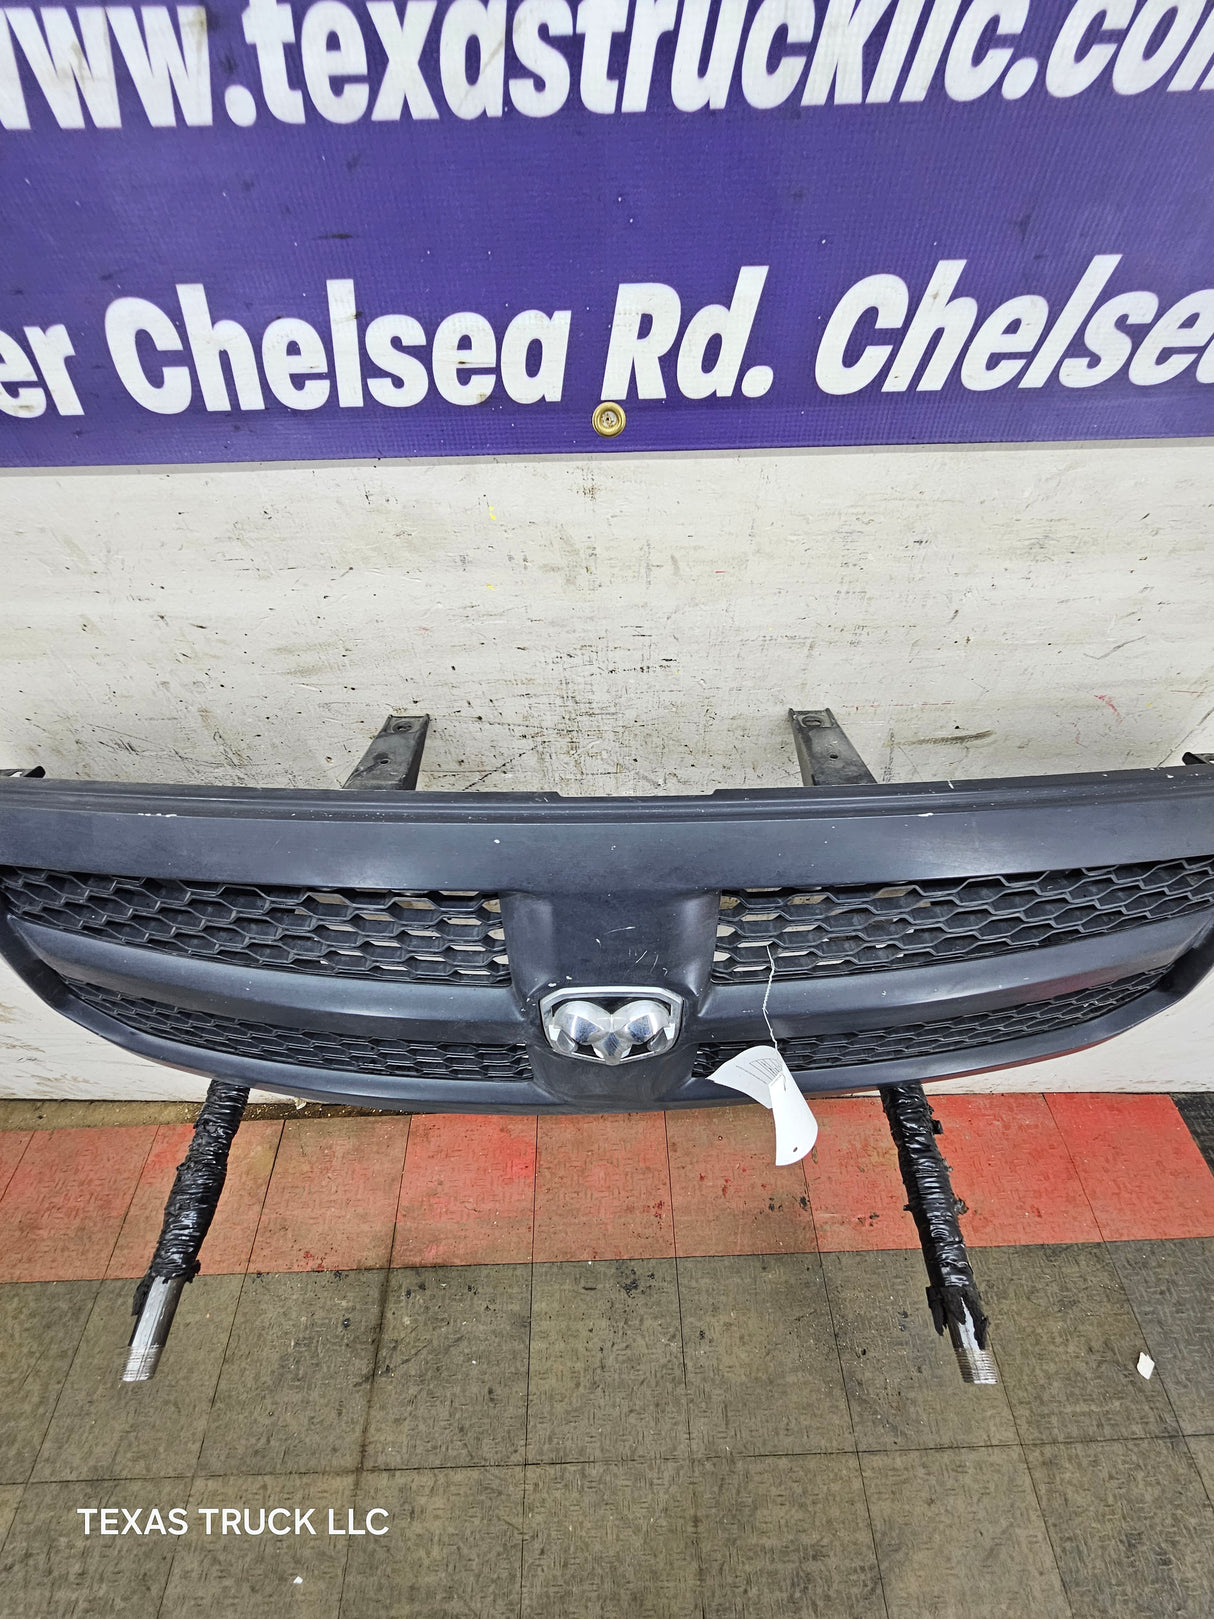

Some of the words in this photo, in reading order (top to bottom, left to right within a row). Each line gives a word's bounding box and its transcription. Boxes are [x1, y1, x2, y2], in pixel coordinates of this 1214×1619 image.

[0, 0, 1214, 130] ww.texastruckllc.co
[105, 279, 571, 414] Chelsea
[601, 266, 773, 400] Rd.
[815, 254, 1214, 395] Chelse
